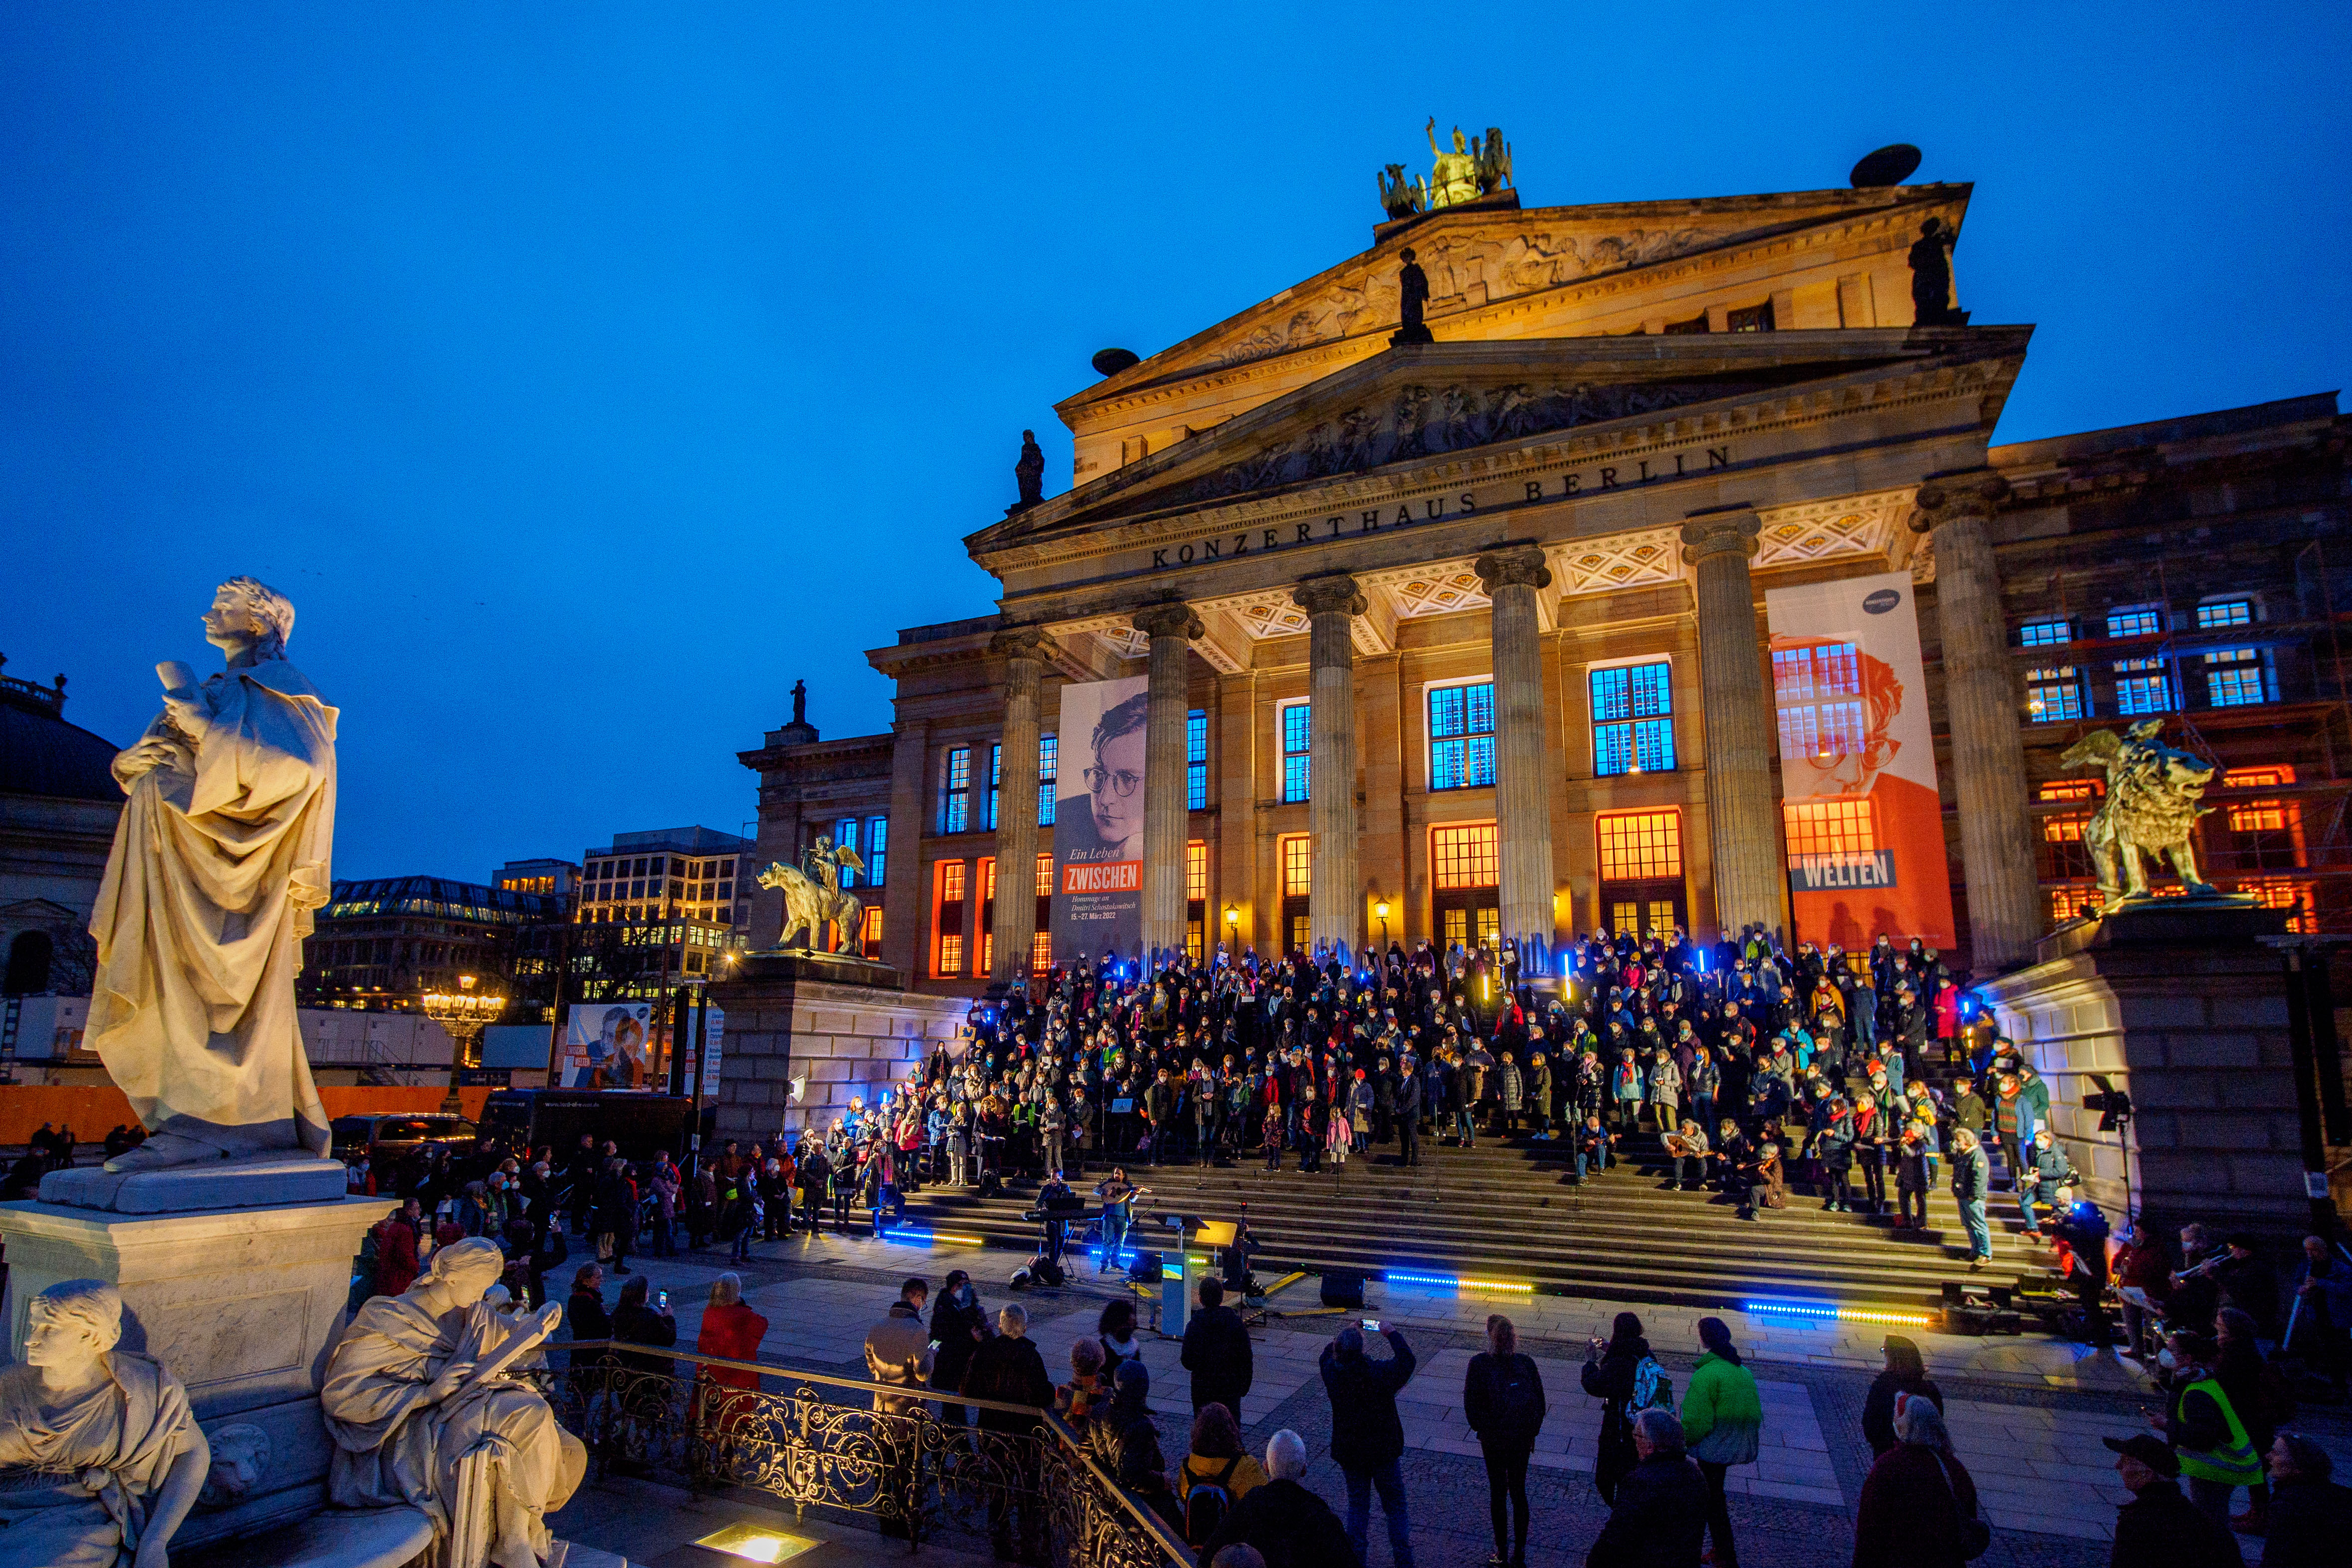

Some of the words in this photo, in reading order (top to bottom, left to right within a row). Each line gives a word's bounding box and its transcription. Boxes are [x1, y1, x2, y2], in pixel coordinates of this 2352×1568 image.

[1153, 492, 1475, 568] KONZERTHAUS
[1525, 446, 1729, 502] BERLIN
[1069, 849, 1087, 860] Ein
[1089, 847, 1119, 859] Leben
[1068, 865, 1137, 890] ZWISCHEN
[1802, 855, 1888, 887] WELTEN
[1091, 902, 1136, 910] Schostakowitsch
